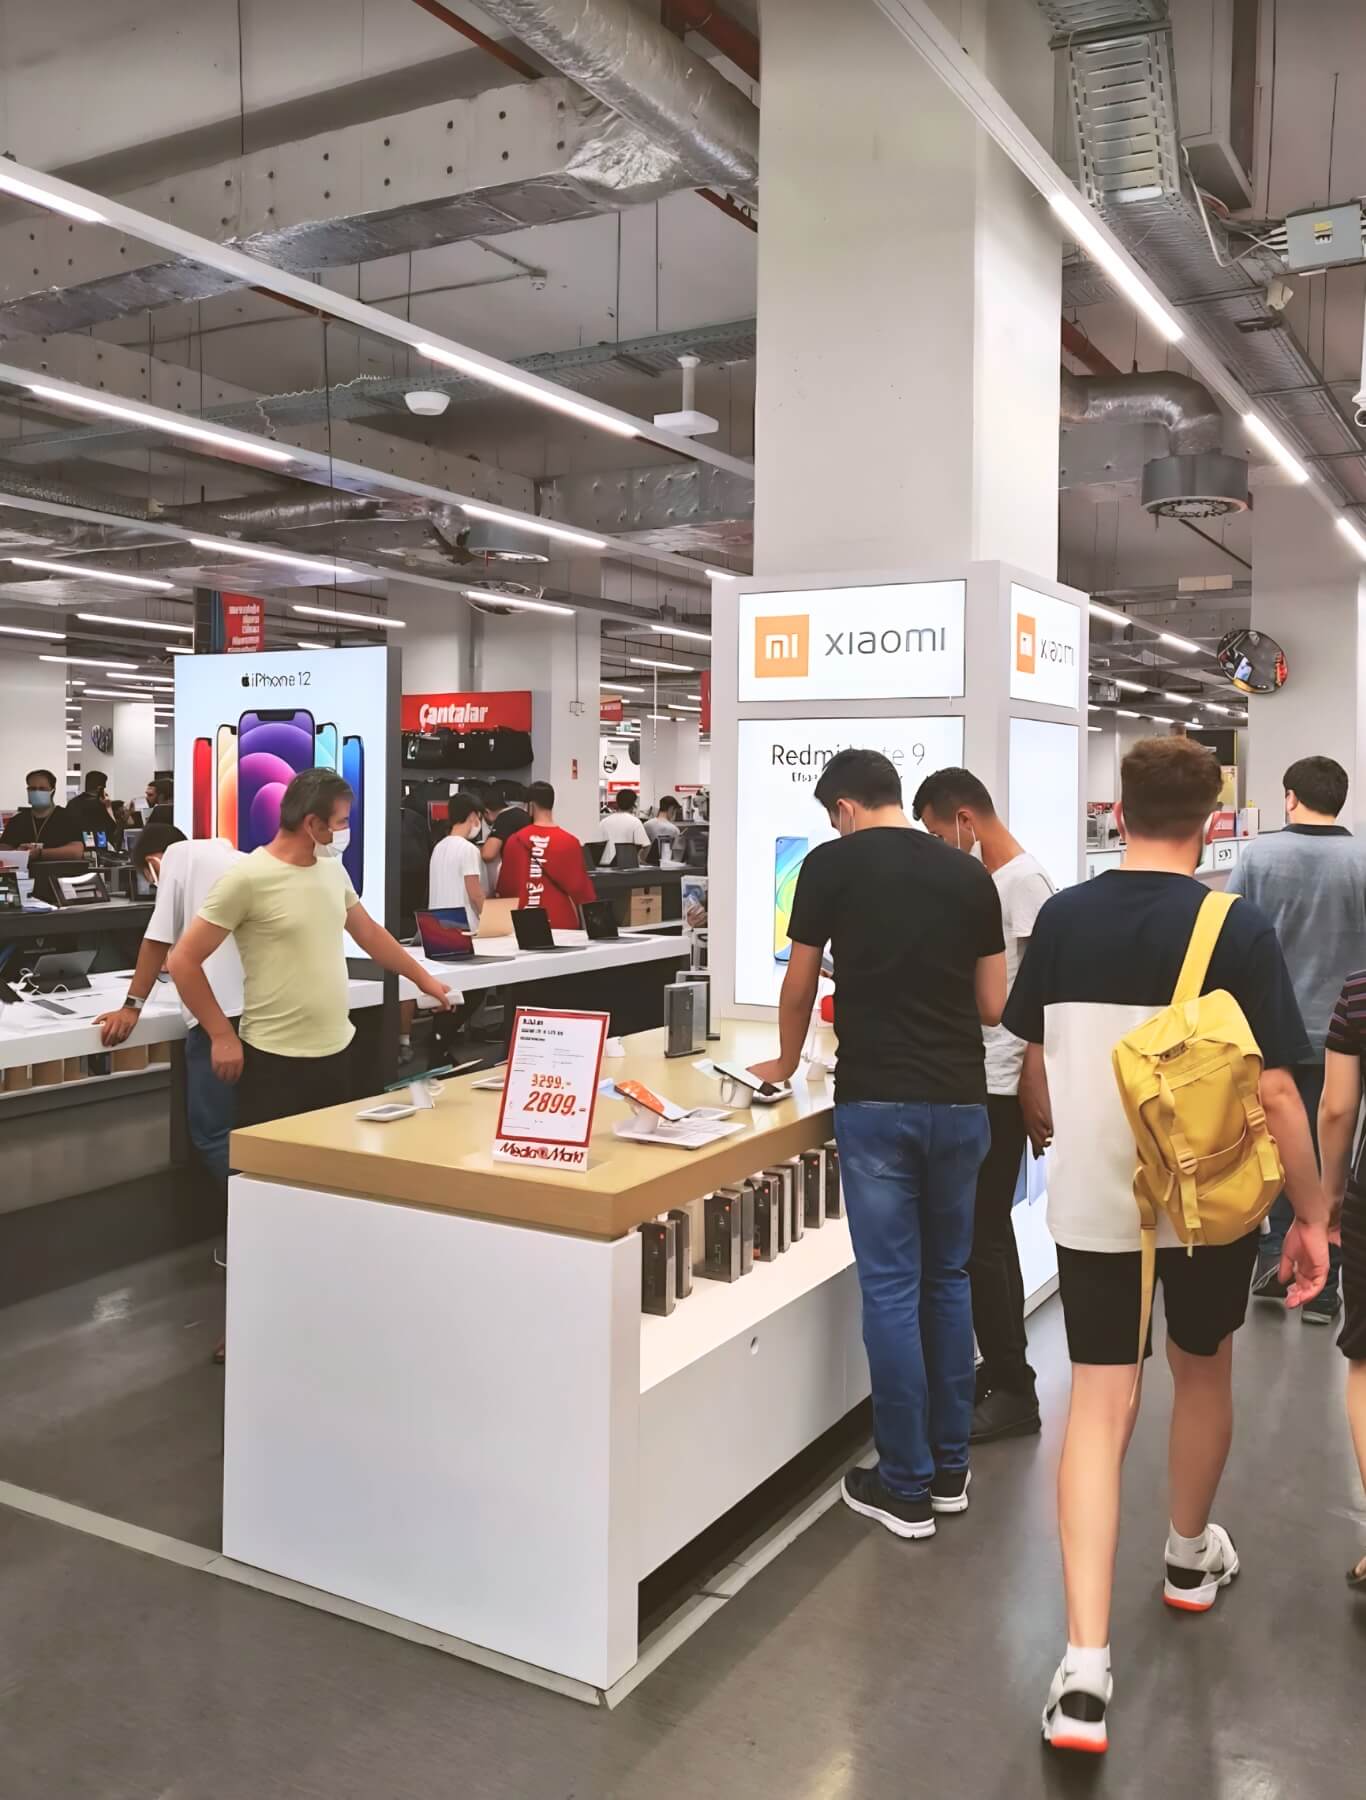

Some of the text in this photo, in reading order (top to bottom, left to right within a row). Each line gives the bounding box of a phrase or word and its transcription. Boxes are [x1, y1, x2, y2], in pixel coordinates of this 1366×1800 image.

[825, 627, 946, 657] xiaomi
[251, 671, 312, 688] iPhone 12
[912, 742, 925, 766] 9
[523, 882, 545, 909] An
